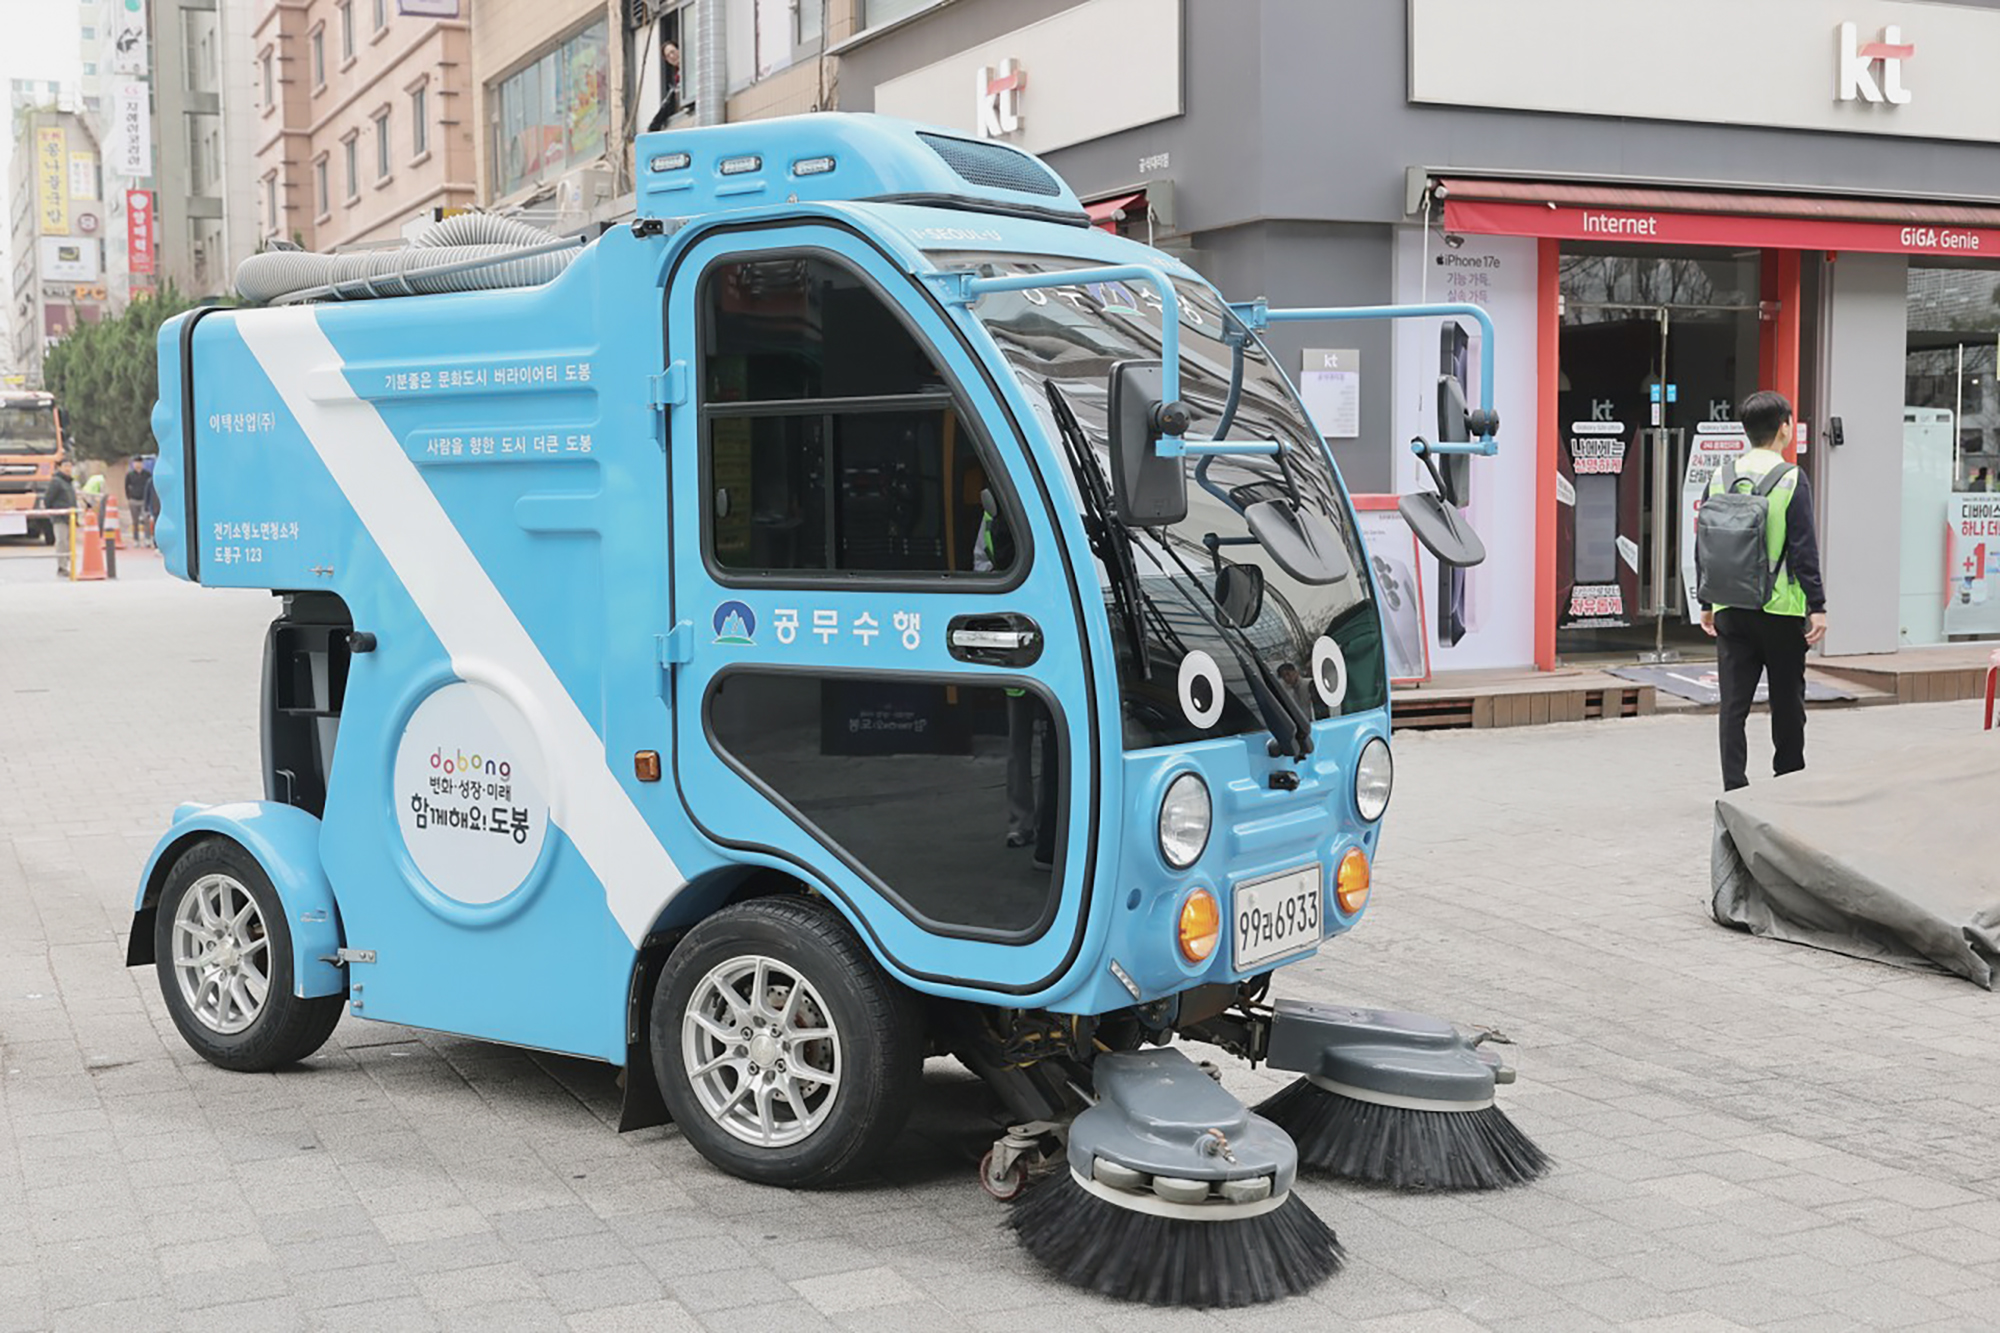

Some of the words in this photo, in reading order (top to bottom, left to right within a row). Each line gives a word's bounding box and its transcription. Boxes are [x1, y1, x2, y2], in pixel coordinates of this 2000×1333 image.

[1833, 20, 1915, 105] kt
[976, 57, 1029, 138] kt
[1583, 212, 1657, 235] Internet
[1901, 227, 1938, 247] GiGA
[1940, 230, 1979, 250] Genie
[1445, 253, 1482, 268] iPhone
[1483, 255, 1501, 269] 17e
[1447, 272, 1467, 286] 기능
[1324, 353, 1339, 368] kt
[385, 372, 432, 390] 기분좋은
[438, 368, 488, 388] 문화도시
[494, 365, 557, 385] 버라이어티
[565, 363, 592, 381] 도봉
[1591, 399, 1614, 420] kt
[1709, 399, 1731, 420] kt
[427, 437, 463, 456] 사람을
[470, 436, 495, 454] 향한
[501, 436, 526, 453] 도시
[533, 435, 559, 453] 더큰
[565, 434, 592, 453] 도봉
[1572, 439, 1625, 456] 나에게는
[1574, 458, 1622, 473] 선명하게
[1962, 504, 2000, 518] 디바이스
[1961, 520, 1985, 536] 하나
[214, 546, 241, 564] 도봉구
[245, 547, 262, 562] 123
[430, 747, 511, 782] dobong
[1240, 891, 1318, 950] 99라6933
